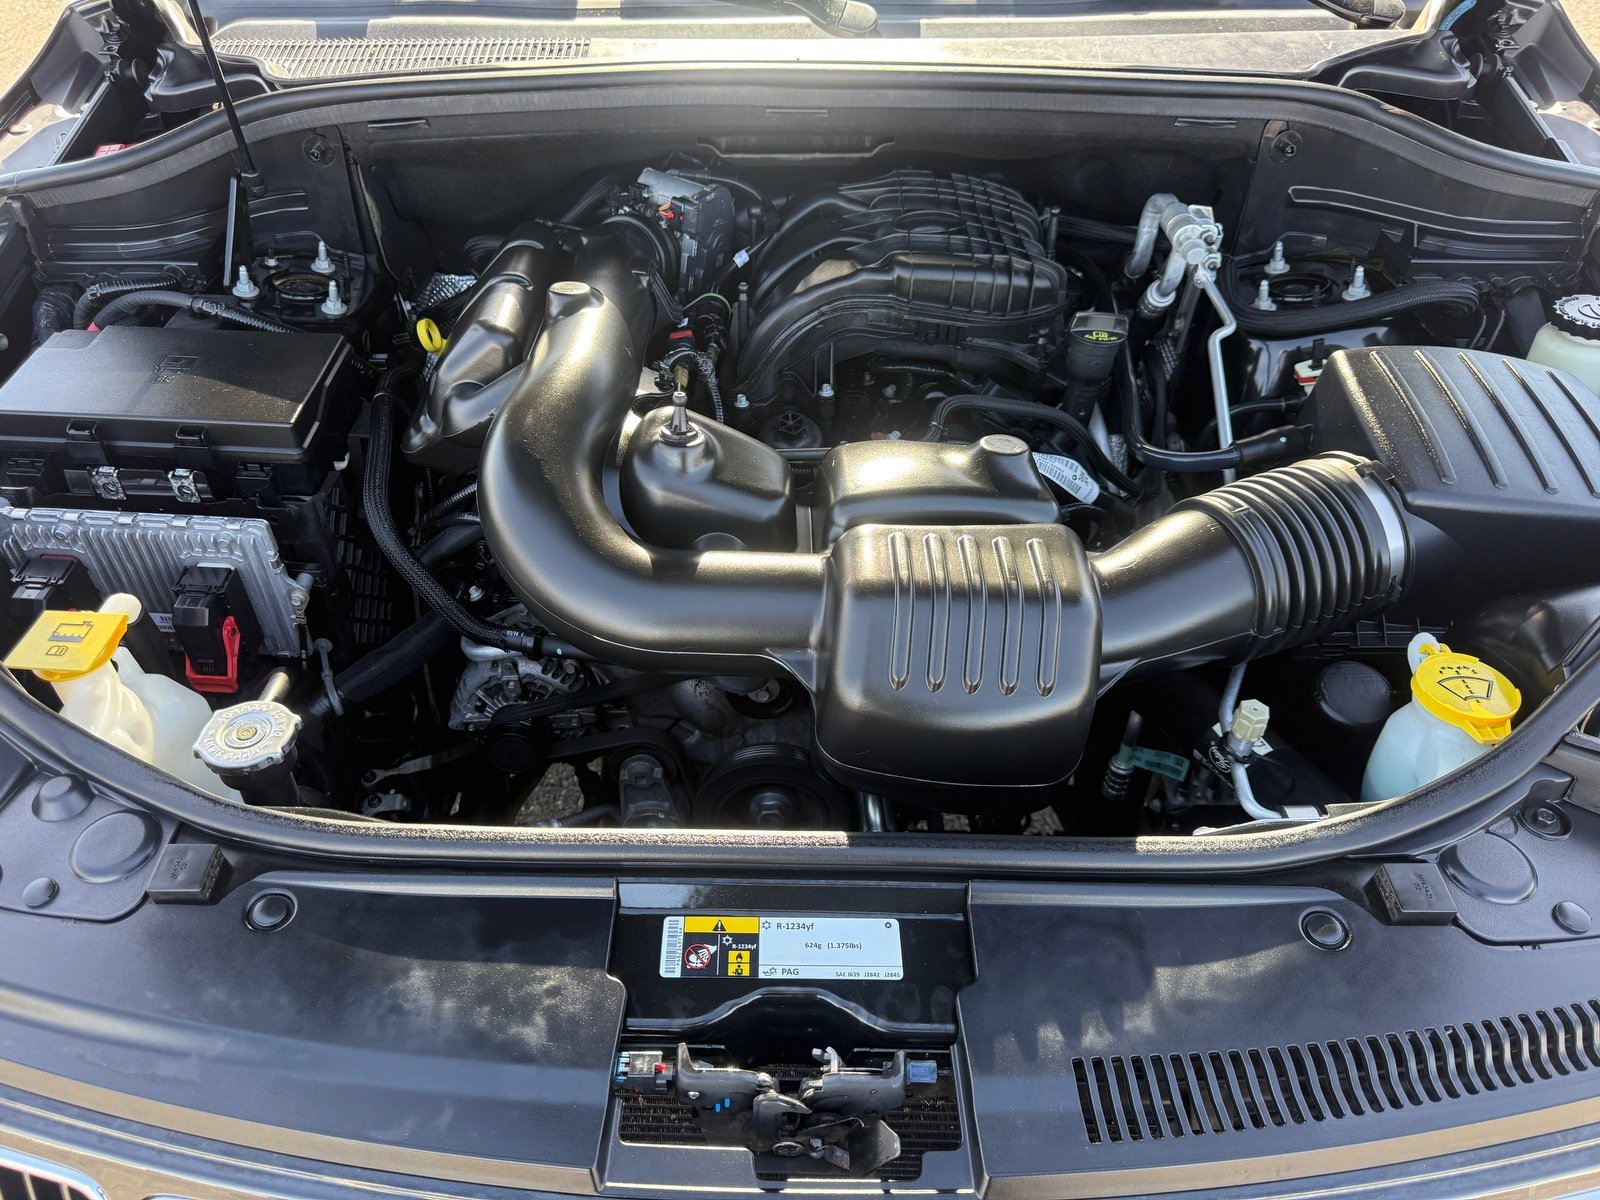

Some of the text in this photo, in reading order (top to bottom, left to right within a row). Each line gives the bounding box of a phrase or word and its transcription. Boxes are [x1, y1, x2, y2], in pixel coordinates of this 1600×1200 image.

[776, 922, 815, 931] R-1234yf
[731, 943, 757, 951] R-1234yf
[804, 942, 862, 950] 624g (1.375lbs)
[781, 968, 799, 976] PAG
